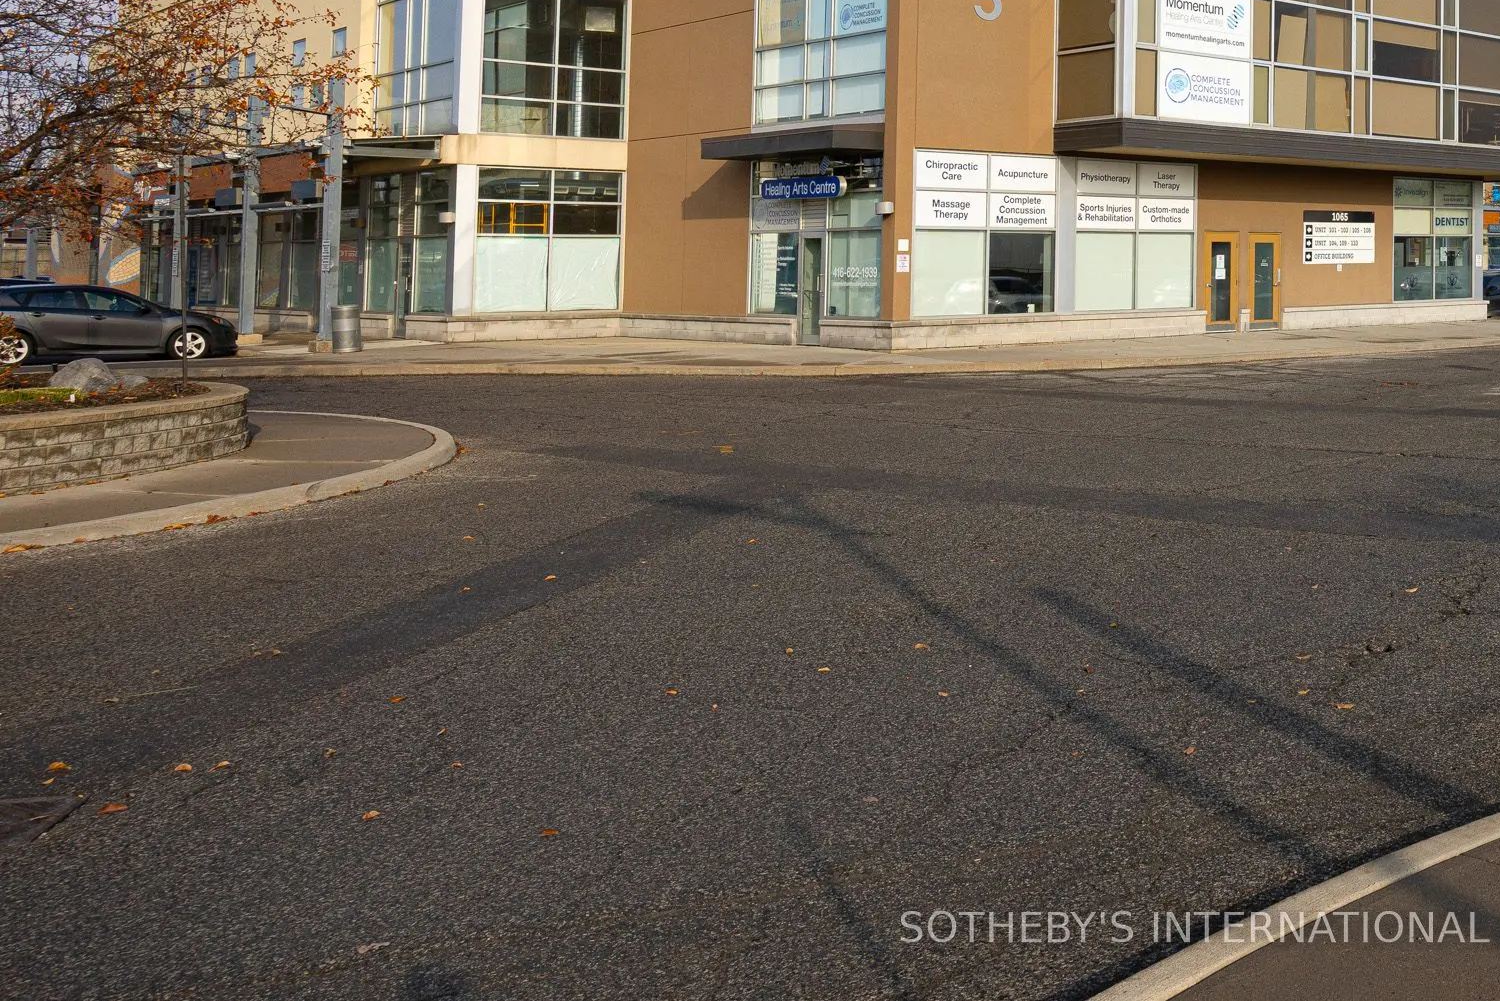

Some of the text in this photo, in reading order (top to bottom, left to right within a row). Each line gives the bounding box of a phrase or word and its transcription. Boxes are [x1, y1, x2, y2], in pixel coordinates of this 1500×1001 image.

[853, 2, 875, 12] COMPLETE
[853, 8, 881, 19] CONCUSSION
[852, 15, 882, 26] MANAGEMENT
[1165, 31, 1245, 47] momentumhealingarts.com
[1191, 74, 1231, 87] COMPLETE
[1193, 84, 1241, 97] CONCUSSION
[1190, 93, 1244, 107] MANAGEMENT
[925, 159, 978, 171] Chiropractic
[941, 171, 962, 181] Care
[997, 168, 1049, 180] Acupuncture
[1080, 172, 1131, 184] Physiotherapy
[1157, 171, 1176, 180] Laser
[765, 180, 837, 198] Healing Arts Centre
[1153, 181, 1180, 191] Therapy
[932, 199, 971, 210] Massage
[1003, 195, 1042, 206] Complete
[999, 205, 1046, 215] Concussion
[1080, 203, 1132, 213] Sports Injuries
[1142, 205, 1190, 214] Custom-made
[934, 209, 968, 220] Therapy
[1077, 213, 1134, 223] & Rehabilitation
[1150, 214, 1182, 223] Orthotics
[1331, 212, 1349, 222] 1065
[996, 215, 1048, 226] Management
[1435, 217, 1469, 226] DENTIST
[833, 267, 878, 278] 416-622-1939
